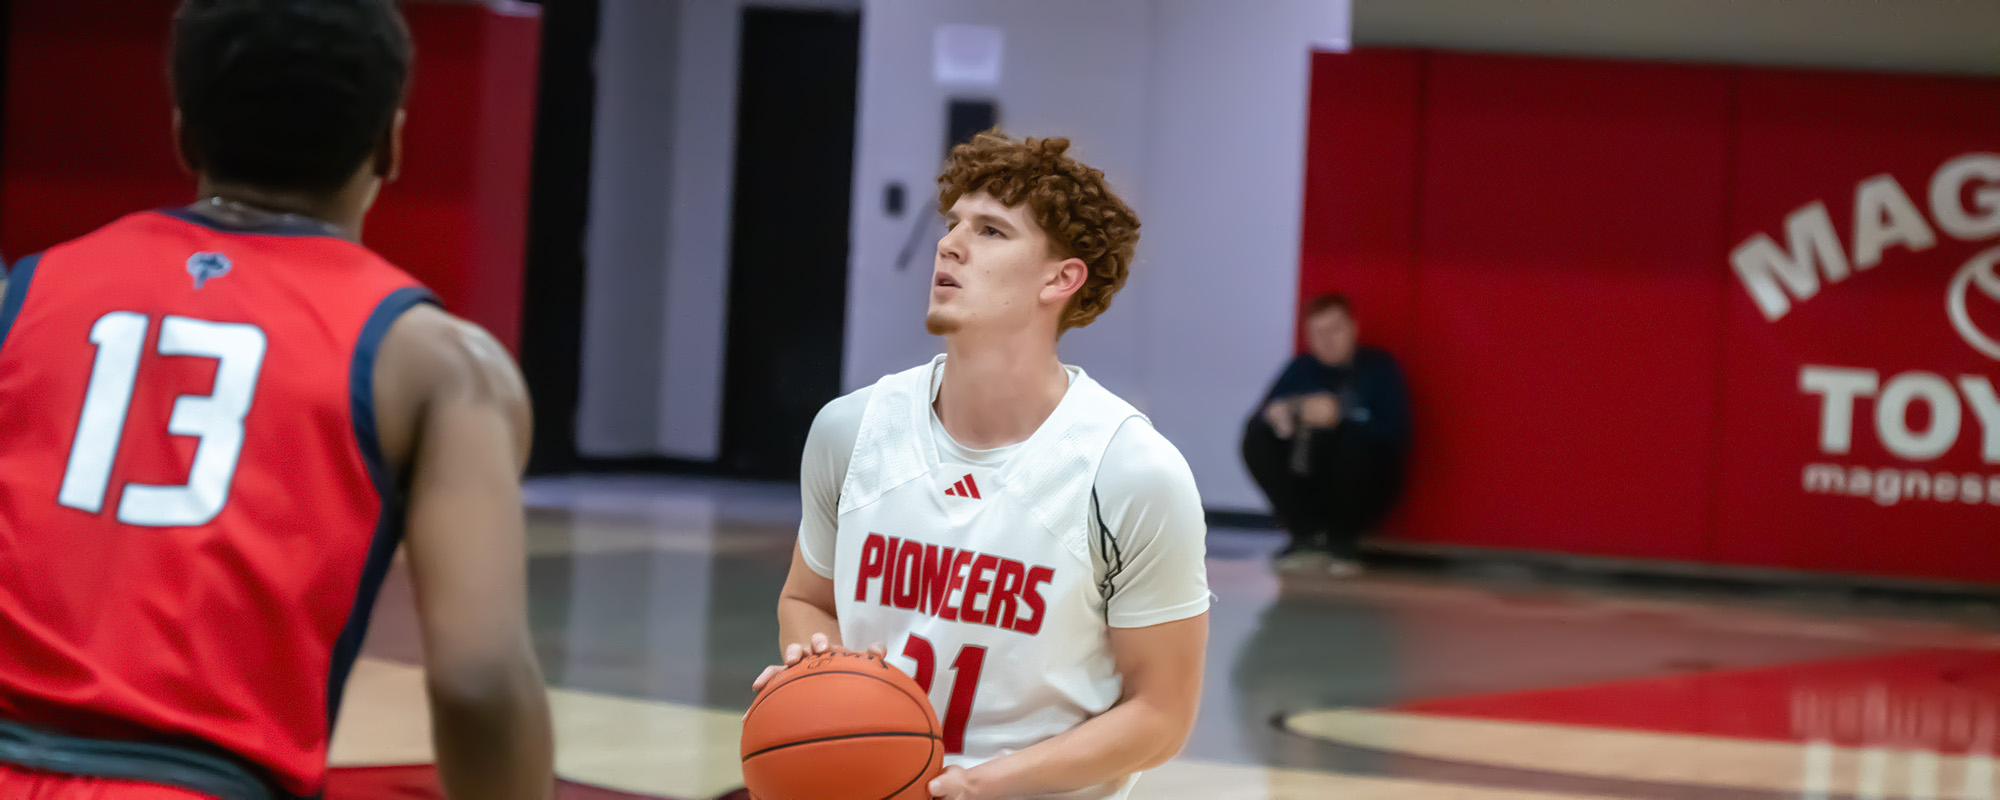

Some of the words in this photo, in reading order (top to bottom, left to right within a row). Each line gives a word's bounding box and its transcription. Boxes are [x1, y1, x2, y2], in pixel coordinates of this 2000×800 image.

[1729, 151, 2000, 321] MAG
[58, 310, 267, 527] 13
[854, 532, 1056, 636] PIONEERS
